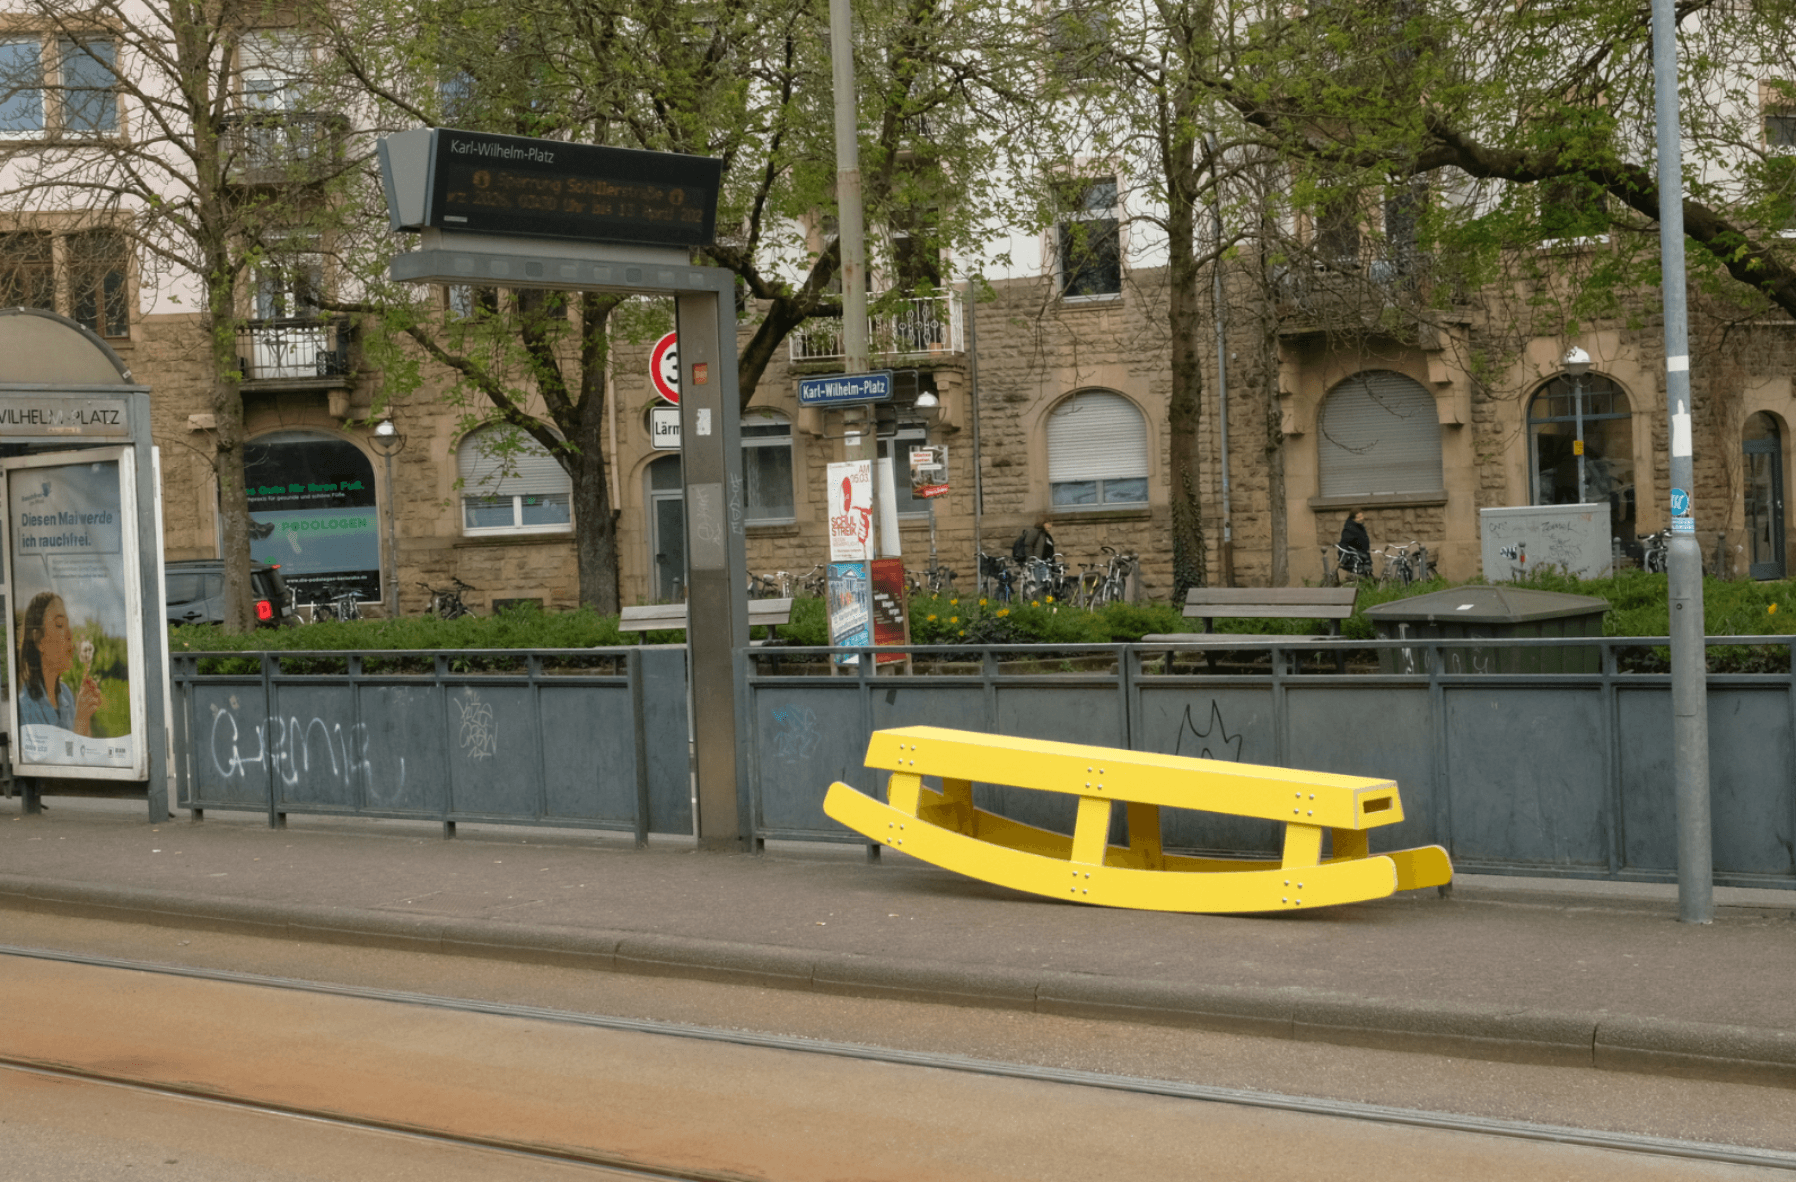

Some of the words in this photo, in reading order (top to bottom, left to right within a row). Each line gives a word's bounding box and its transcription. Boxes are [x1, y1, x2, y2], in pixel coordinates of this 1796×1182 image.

[450, 139, 555, 164] Karl-Wilhelm-Platz
[802, 379, 886, 400] Karl-Wilhelm-Platz
[21, 512, 57, 527] Diesen
[58, 511, 78, 525] Mai
[79, 510, 113, 525] werde
[282, 518, 367, 531] PODOLOGEN
[21, 533, 37, 548] ich
[38, 532, 93, 548] rauchfrei.
